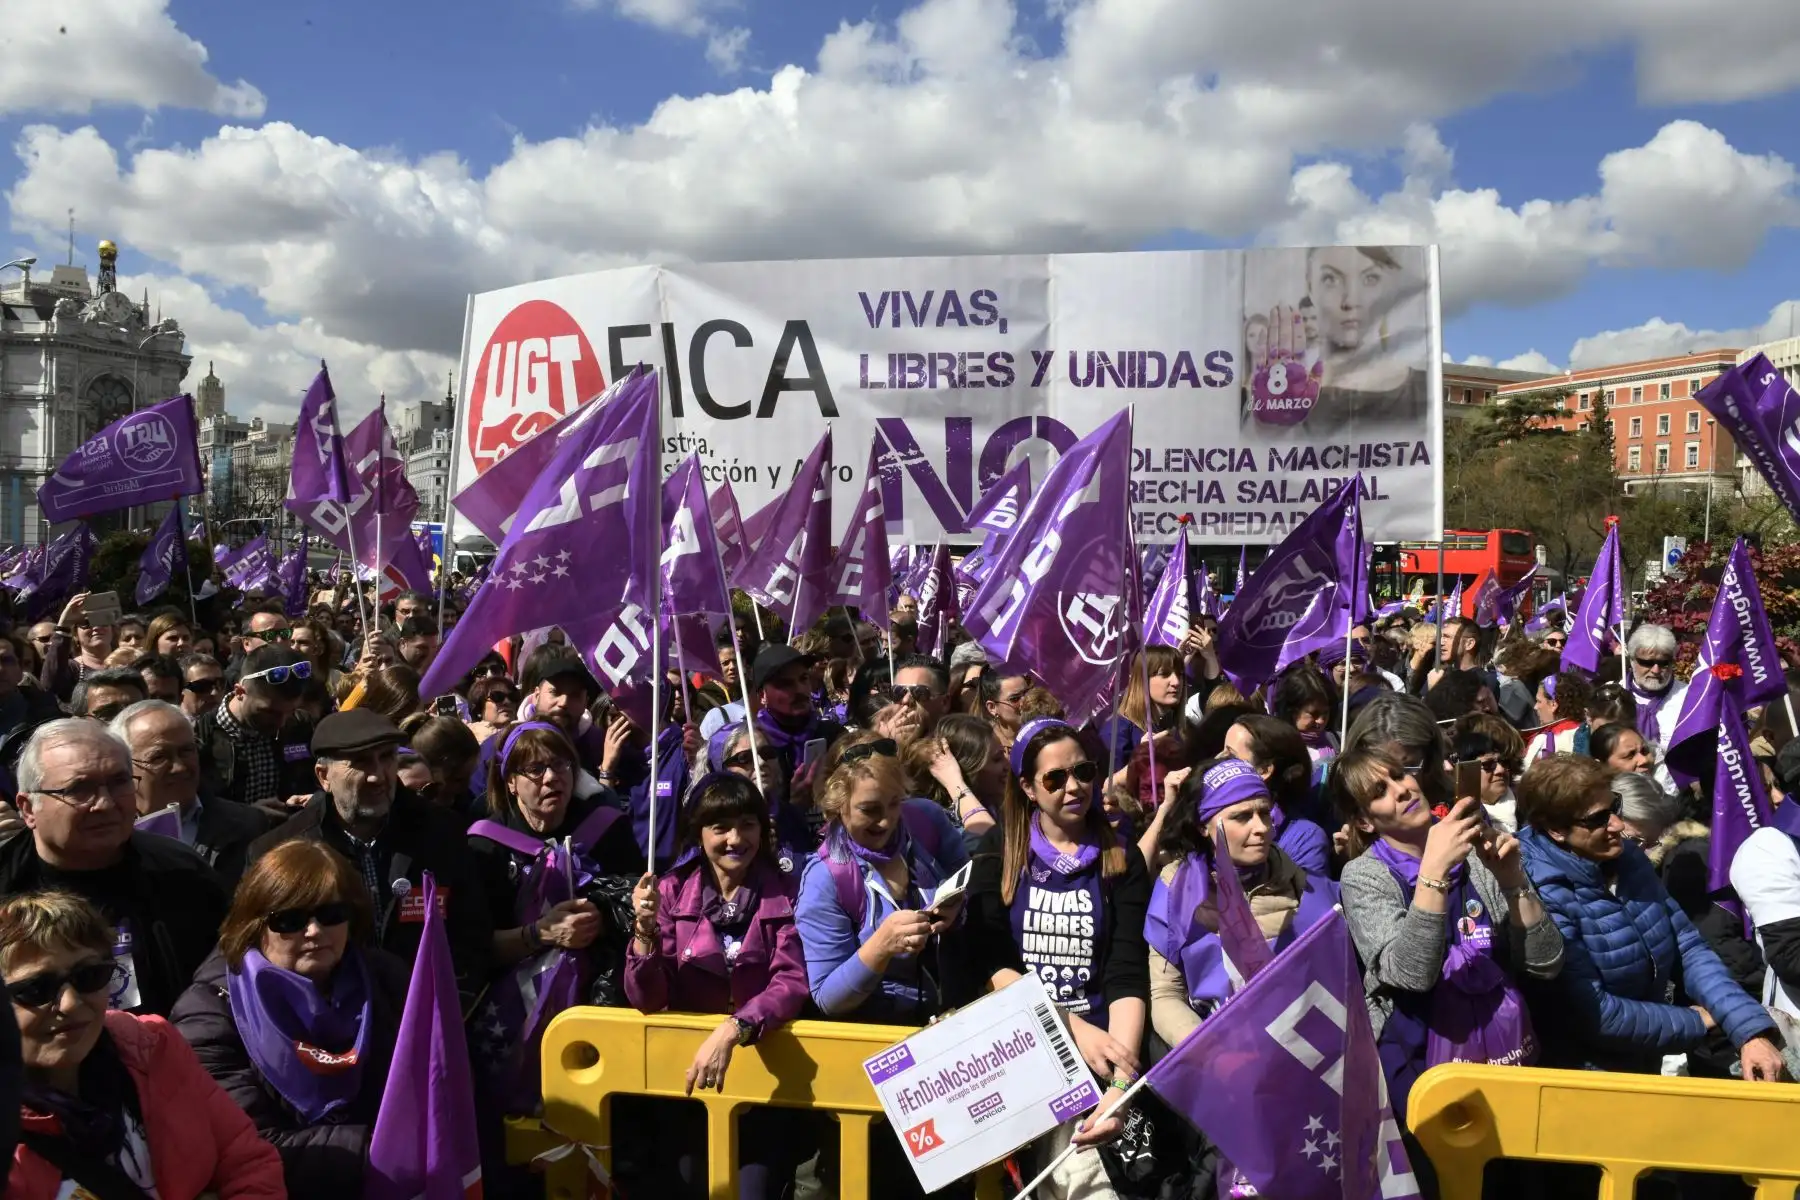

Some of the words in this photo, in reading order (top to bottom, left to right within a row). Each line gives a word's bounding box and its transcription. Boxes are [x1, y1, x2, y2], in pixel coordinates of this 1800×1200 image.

[858, 289, 1008, 334] VIVAS,
[482, 335, 582, 426] UGT
[608, 319, 840, 420] FICA
[859, 351, 1016, 389] LIBRES
[1031, 350, 1055, 388] Y
[1069, 350, 1234, 388] UNIDAS
[1267, 363, 1288, 395] 8
[1266, 398, 1312, 410] MARZO
[1131, 447, 1257, 472] OLENCIA
[1268, 441, 1431, 473] MACHISTA
[768, 465, 782, 489] y
[1029, 886, 1093, 913] VIVAS
[1023, 910, 1094, 937] LIBRES
[1022, 933, 1094, 957] UNIDAS
[1022, 953, 1039, 965] POR
[1041, 954, 1051, 965] LA
[1052, 955, 1092, 967] IGUALDAD
[870, 1048, 908, 1074] CCOO
[896, 1028, 1036, 1117] #EnDiaNoSobraNadie
[969, 1093, 1002, 1116] CCOO
[1051, 1082, 1092, 1112] CCOO
[973, 1103, 1007, 1125] servicios
